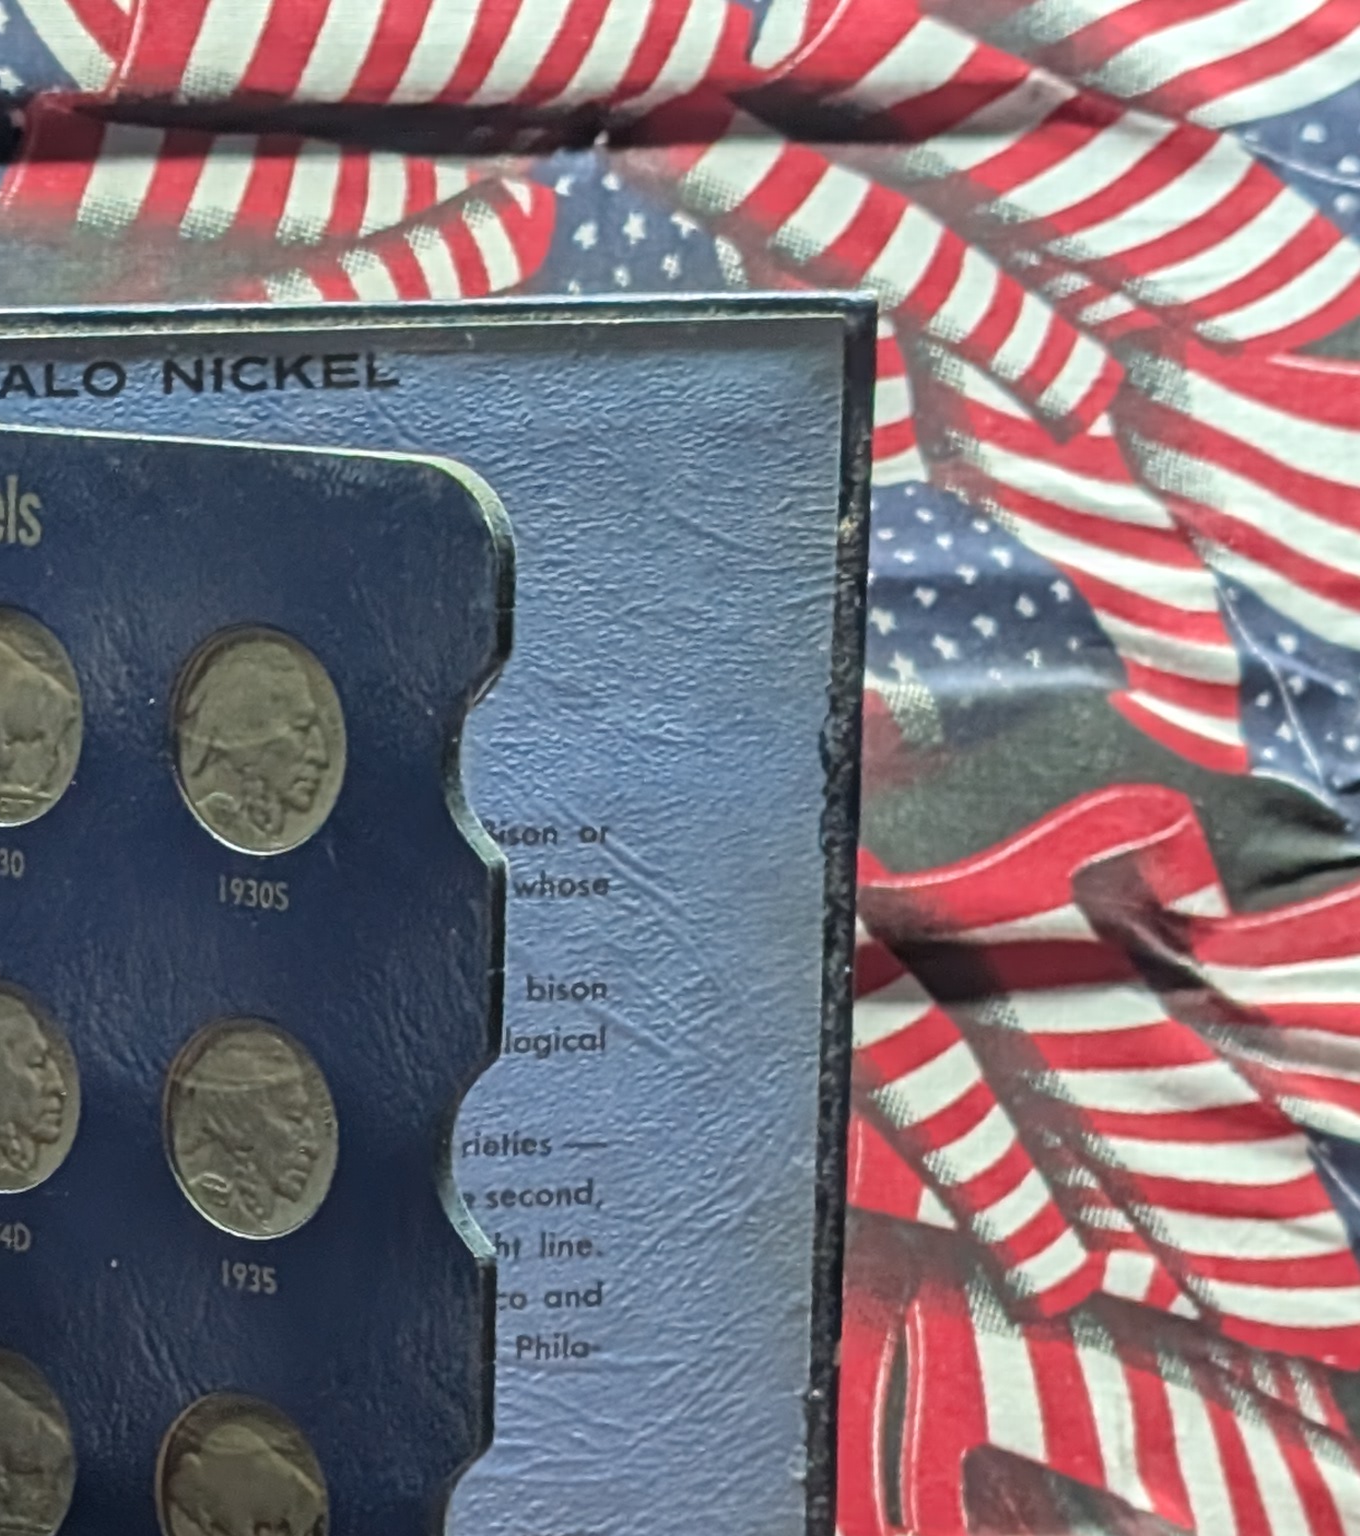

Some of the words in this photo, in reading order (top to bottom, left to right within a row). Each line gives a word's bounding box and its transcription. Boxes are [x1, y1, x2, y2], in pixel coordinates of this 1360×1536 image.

[162, 353, 401, 395] NICKEL
[579, 826, 608, 845] or
[219, 877, 290, 911] 1930S
[513, 870, 610, 898] whose
[526, 974, 607, 1001] bison
[486, 1179, 603, 1212] second,
[541, 1233, 602, 1258] line.
[222, 1261, 277, 1294] 1935
[545, 1282, 604, 1308] and
